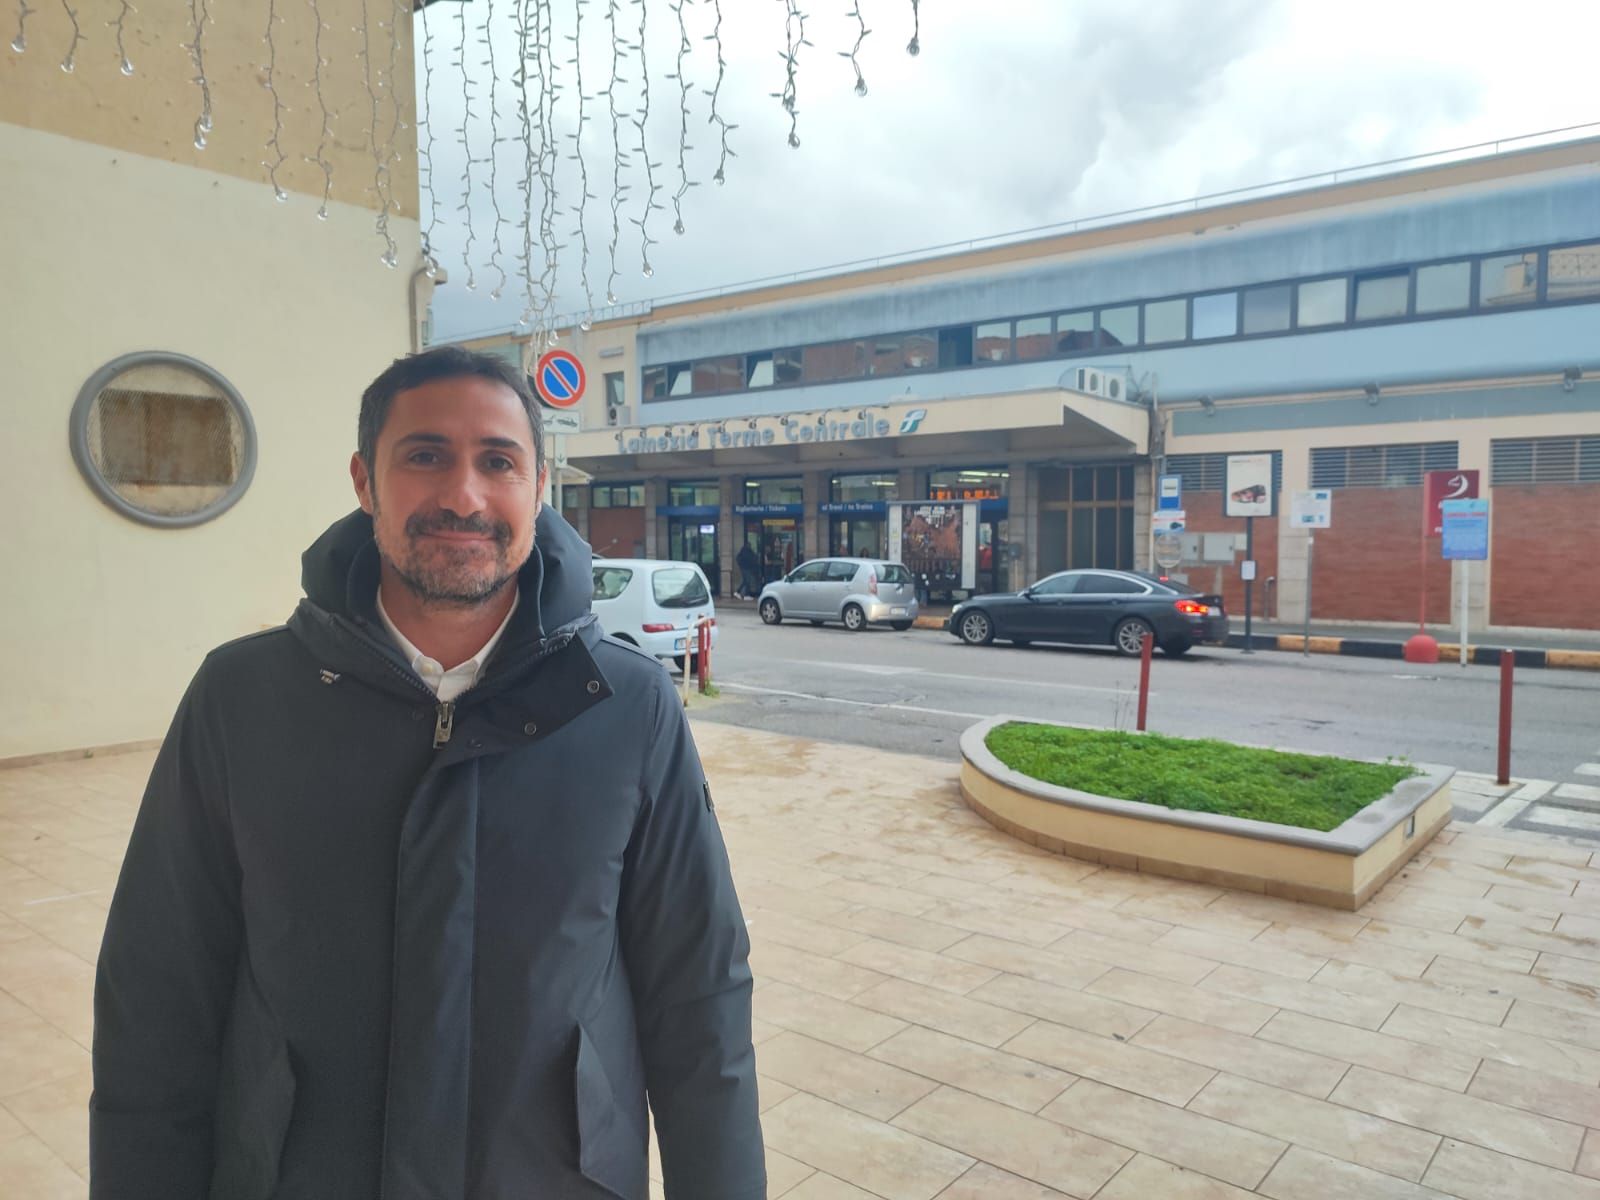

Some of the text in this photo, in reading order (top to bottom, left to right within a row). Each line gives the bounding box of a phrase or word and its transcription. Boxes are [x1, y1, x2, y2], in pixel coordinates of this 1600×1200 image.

[617, 412, 890, 454] Lamezia Terme Centrale
